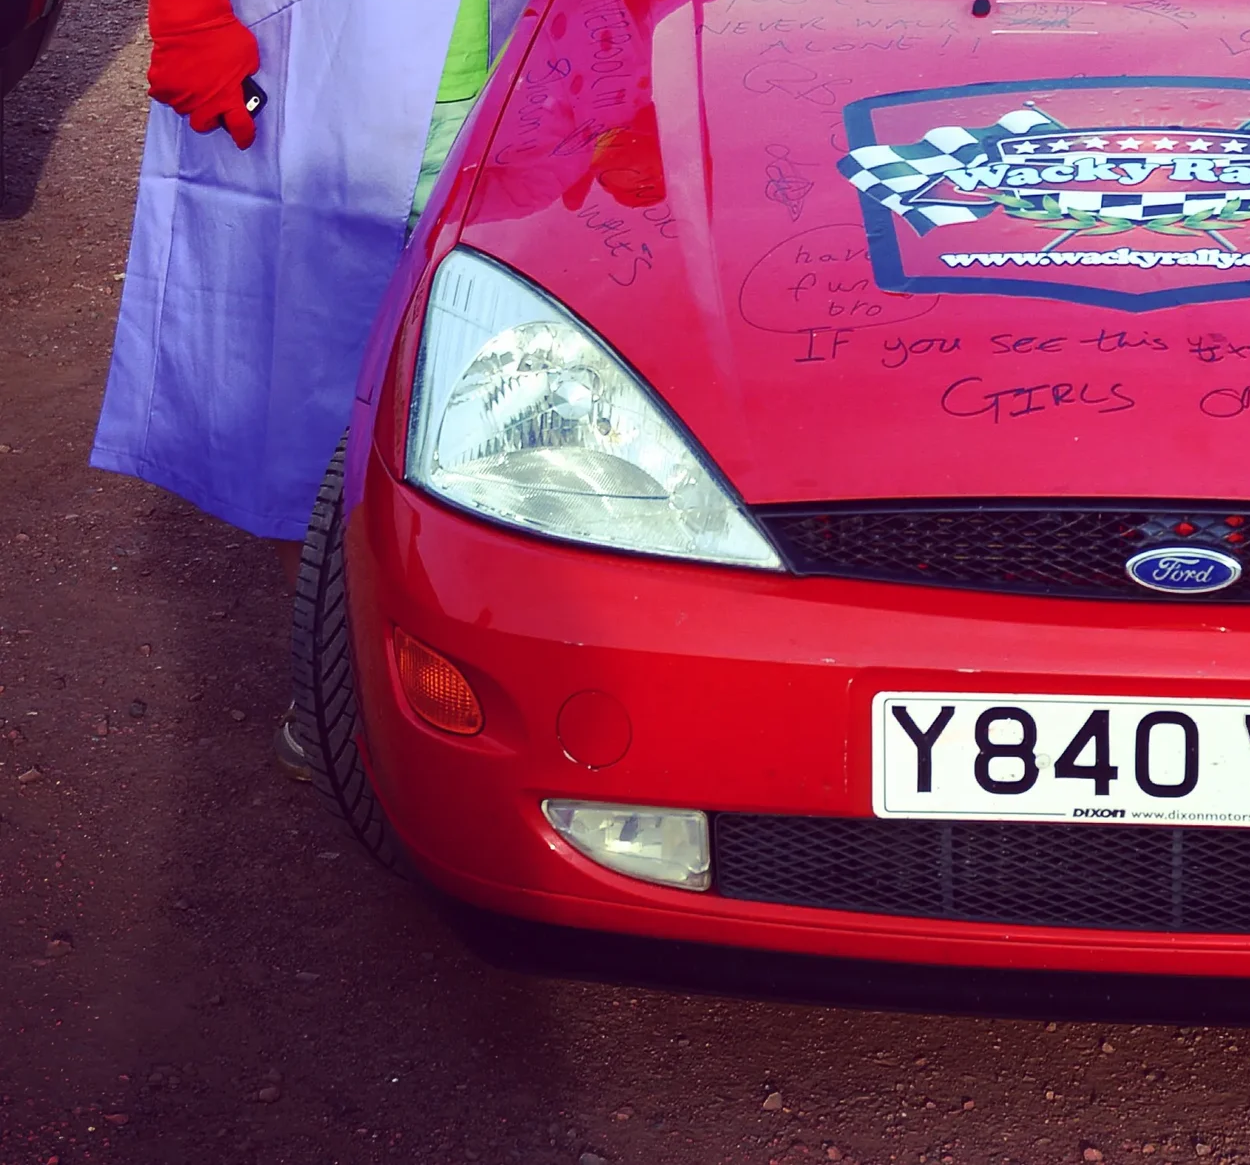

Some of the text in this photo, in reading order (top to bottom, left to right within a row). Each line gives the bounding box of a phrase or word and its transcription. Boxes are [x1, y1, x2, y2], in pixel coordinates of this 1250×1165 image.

[696, 16, 961, 35] NEVER WALK
[942, 154, 1163, 193] Wacky
[828, 299, 882, 317] bro
[882, 334, 961, 368] you
[1079, 328, 1169, 352] this
[941, 376, 1135, 424] GIRLS
[1152, 556, 1214, 584] Ford
[891, 705, 1200, 799] Y840
